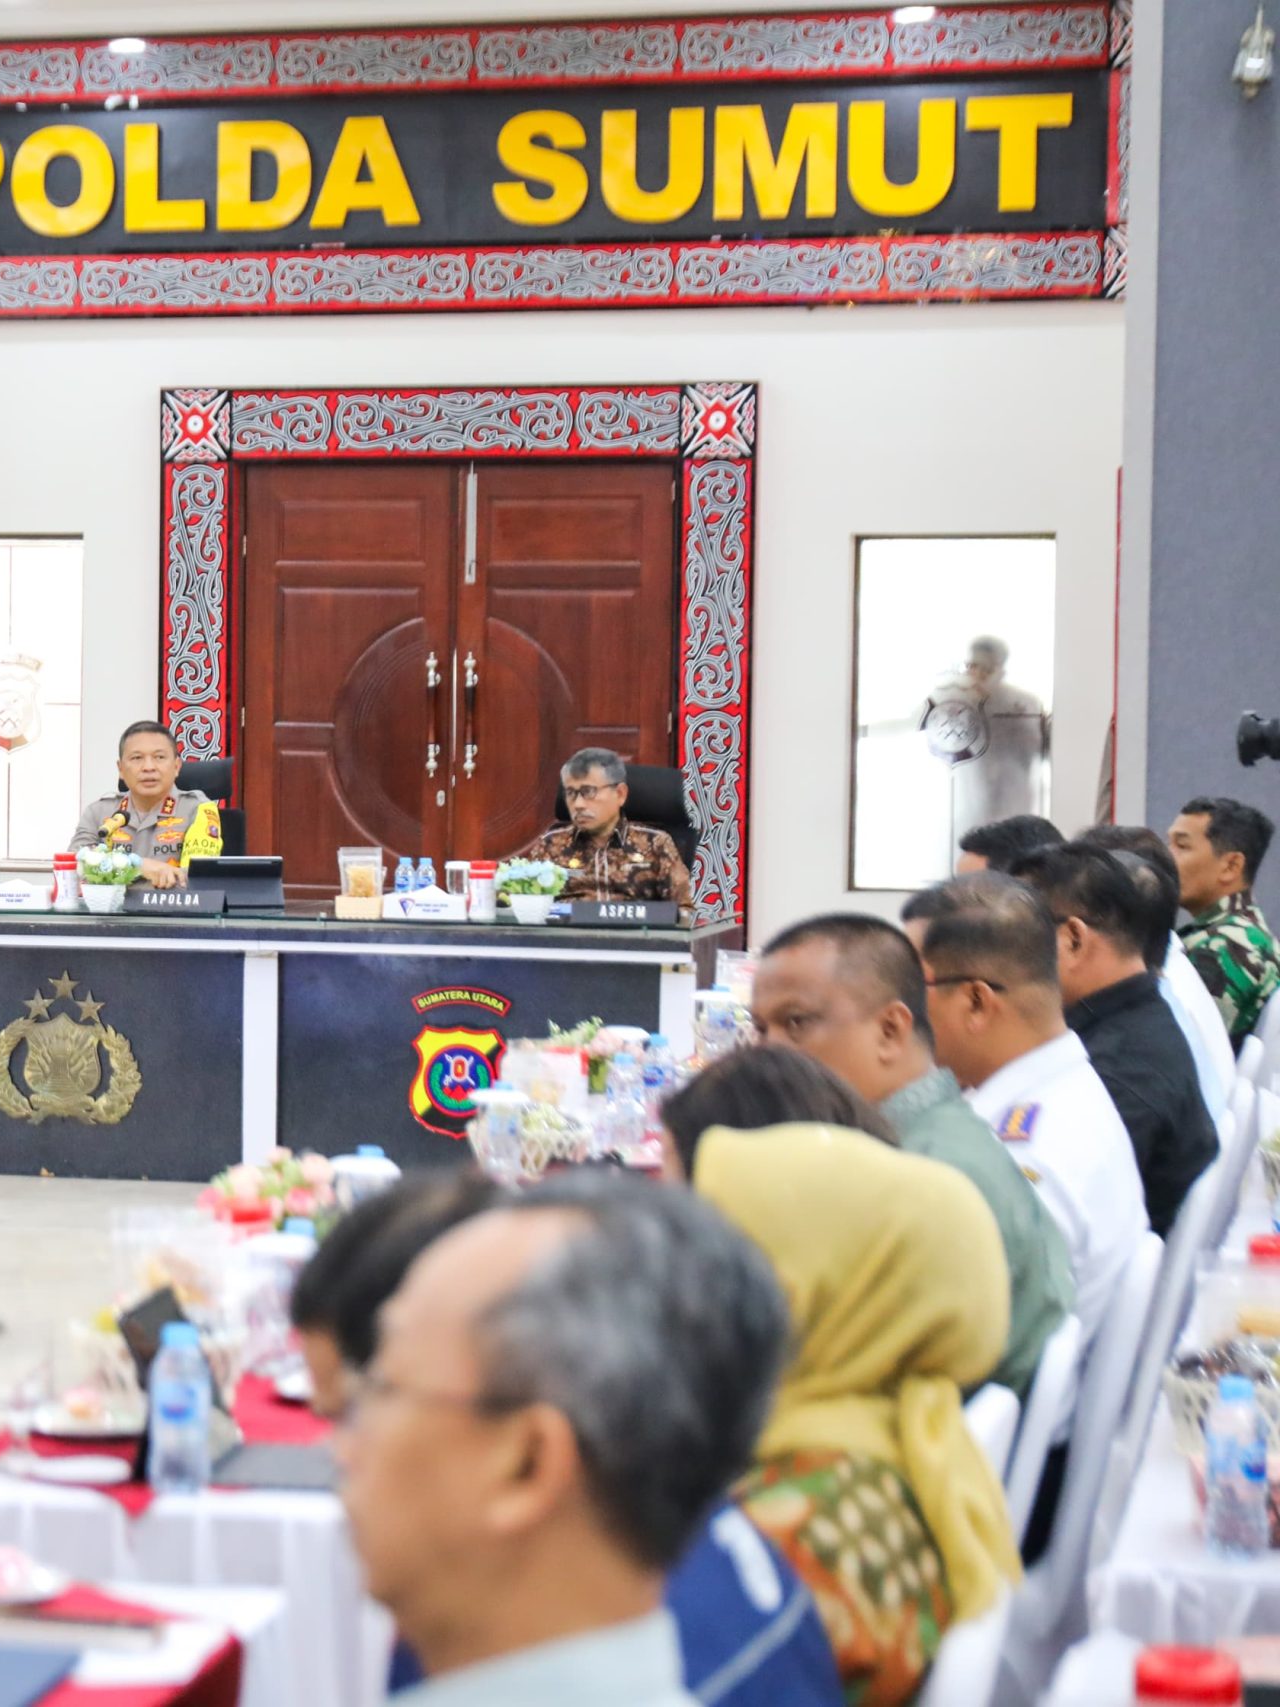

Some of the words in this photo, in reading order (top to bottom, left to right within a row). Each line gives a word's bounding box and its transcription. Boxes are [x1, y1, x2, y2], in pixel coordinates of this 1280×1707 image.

[493, 94, 1072, 225] SUMUT
[142, 892, 200, 906] KAPOLDA
[599, 904, 647, 919] ASPEM
[417, 990, 471, 1009] SUMATERA
[471, 992, 504, 1011] UTARA
